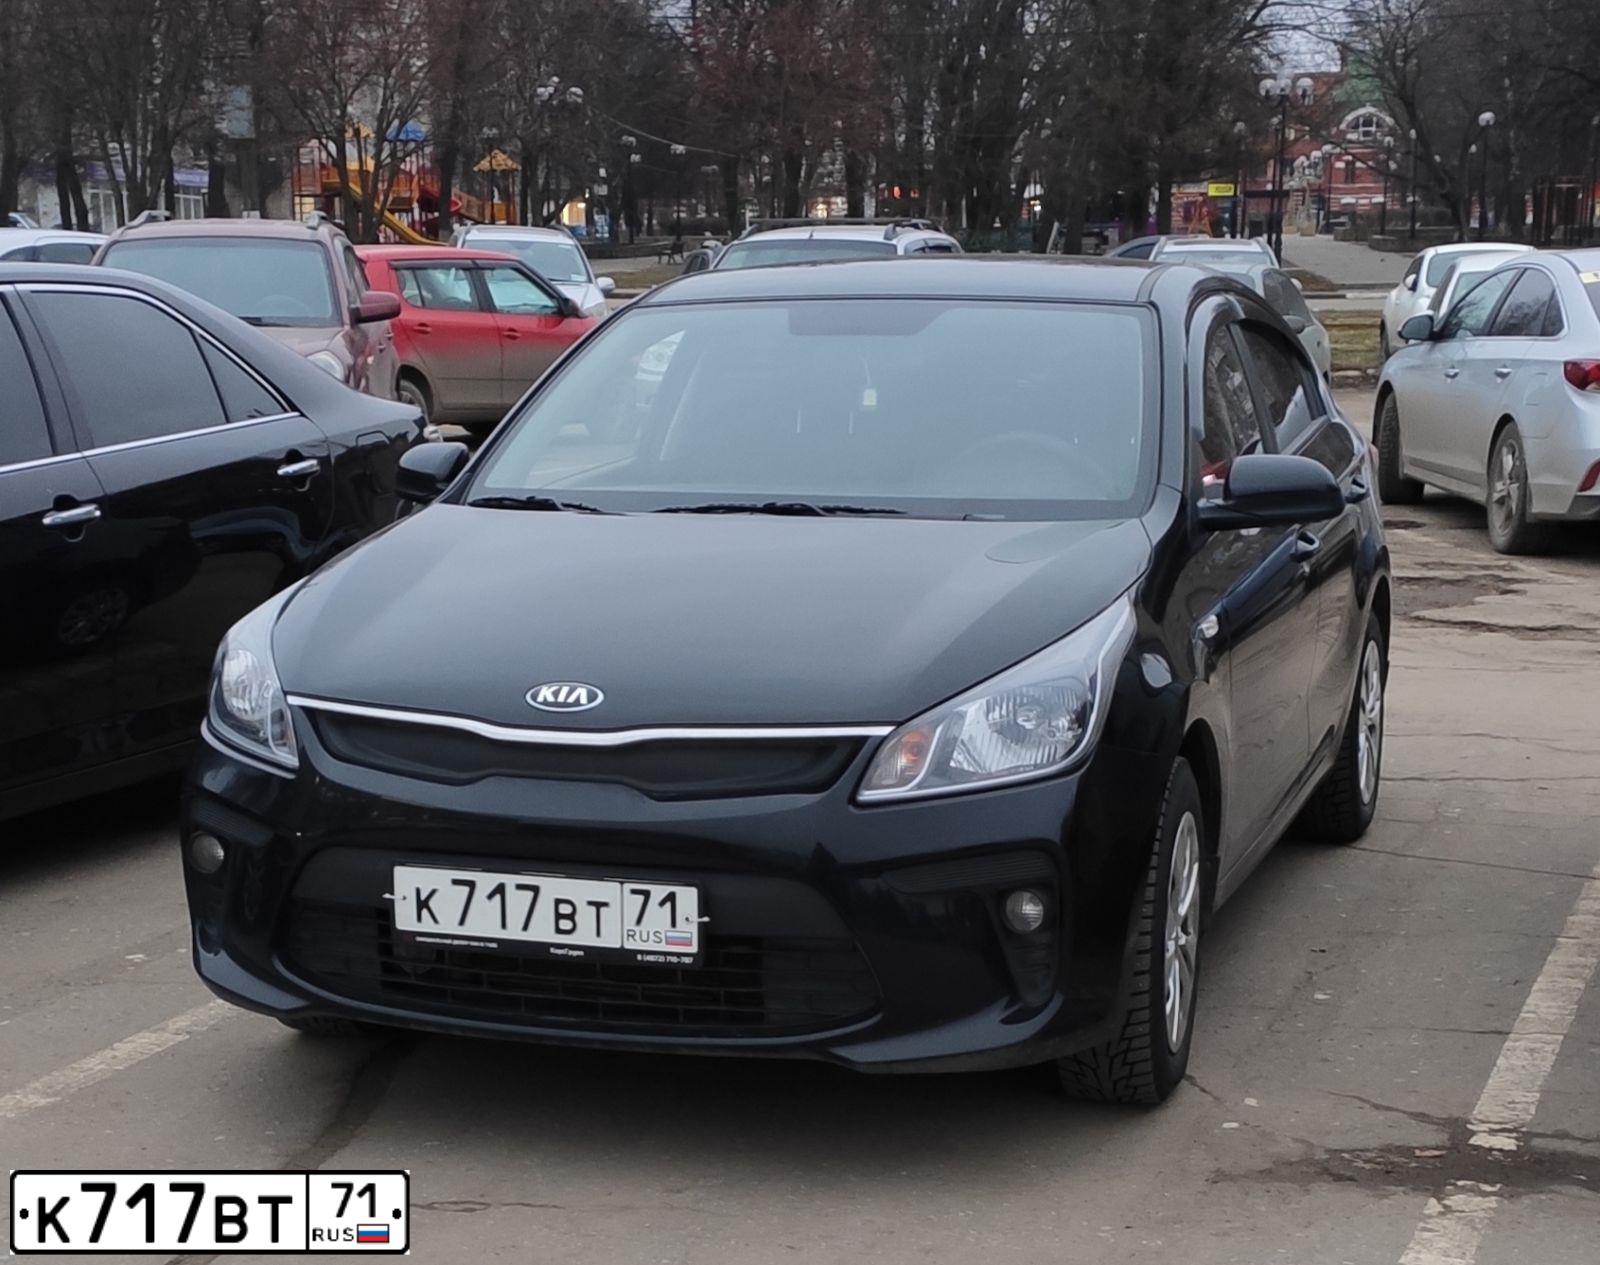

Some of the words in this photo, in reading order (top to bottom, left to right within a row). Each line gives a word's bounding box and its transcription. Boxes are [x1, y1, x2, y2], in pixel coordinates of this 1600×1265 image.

[536, 685, 588, 704] KIA
[629, 888, 677, 928] 71
[626, 928, 663, 944] RUS
